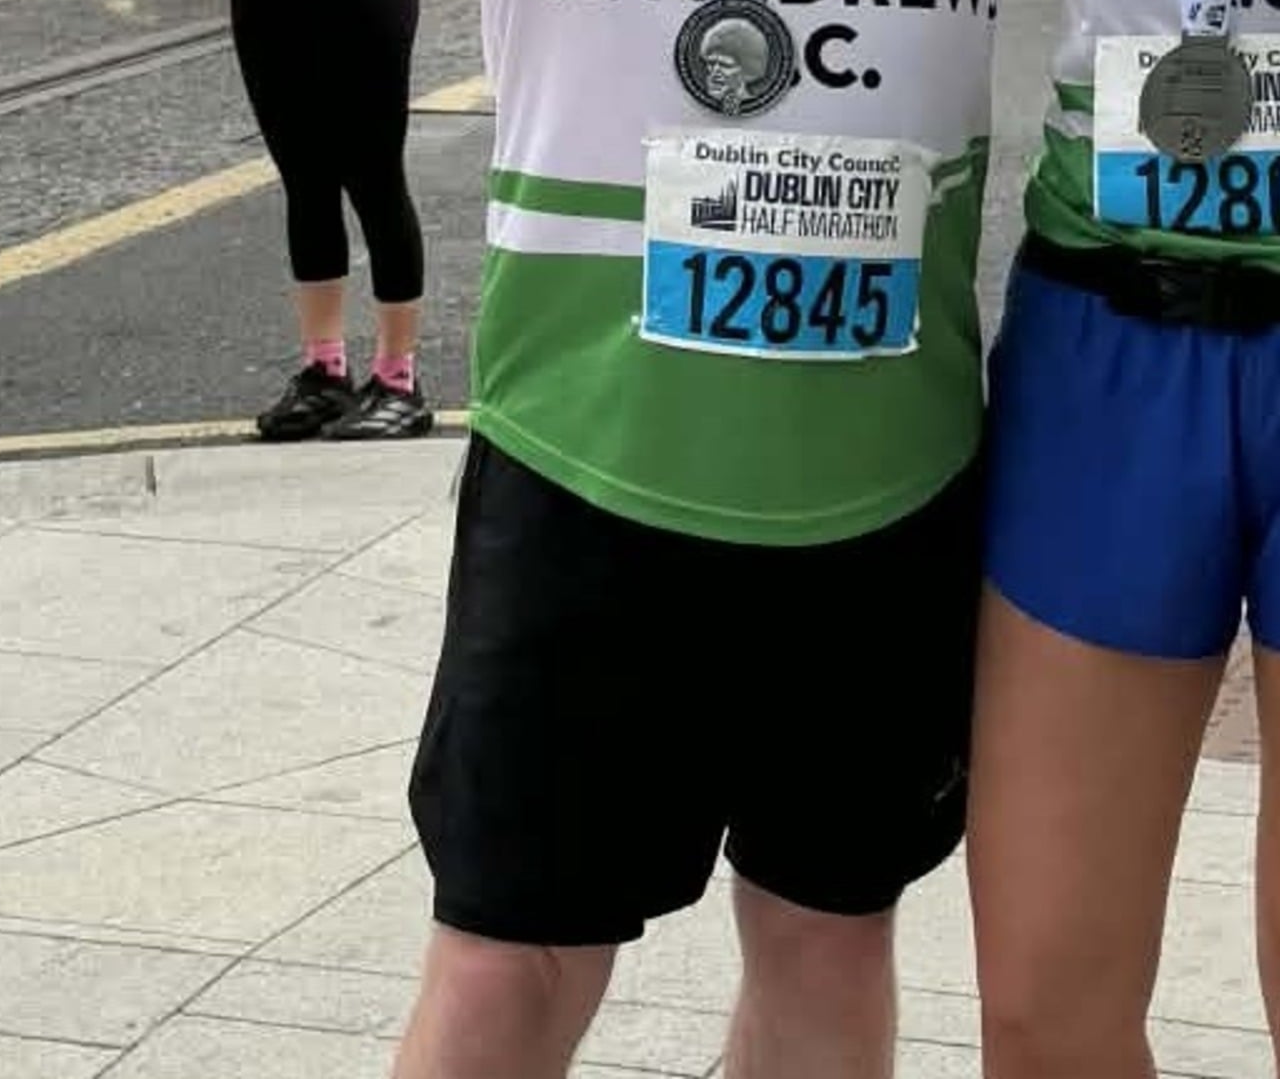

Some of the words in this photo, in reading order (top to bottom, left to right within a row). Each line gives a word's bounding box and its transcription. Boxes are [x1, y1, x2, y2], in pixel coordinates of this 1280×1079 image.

[694, 142, 769, 166] Dublin
[777, 148, 823, 172] City
[744, 170, 842, 209] DUBLIN
[847, 177, 901, 211] CITY
[740, 205, 796, 237] HALF
[797, 209, 899, 241] MARATHON
[682, 251, 894, 349] 12845
